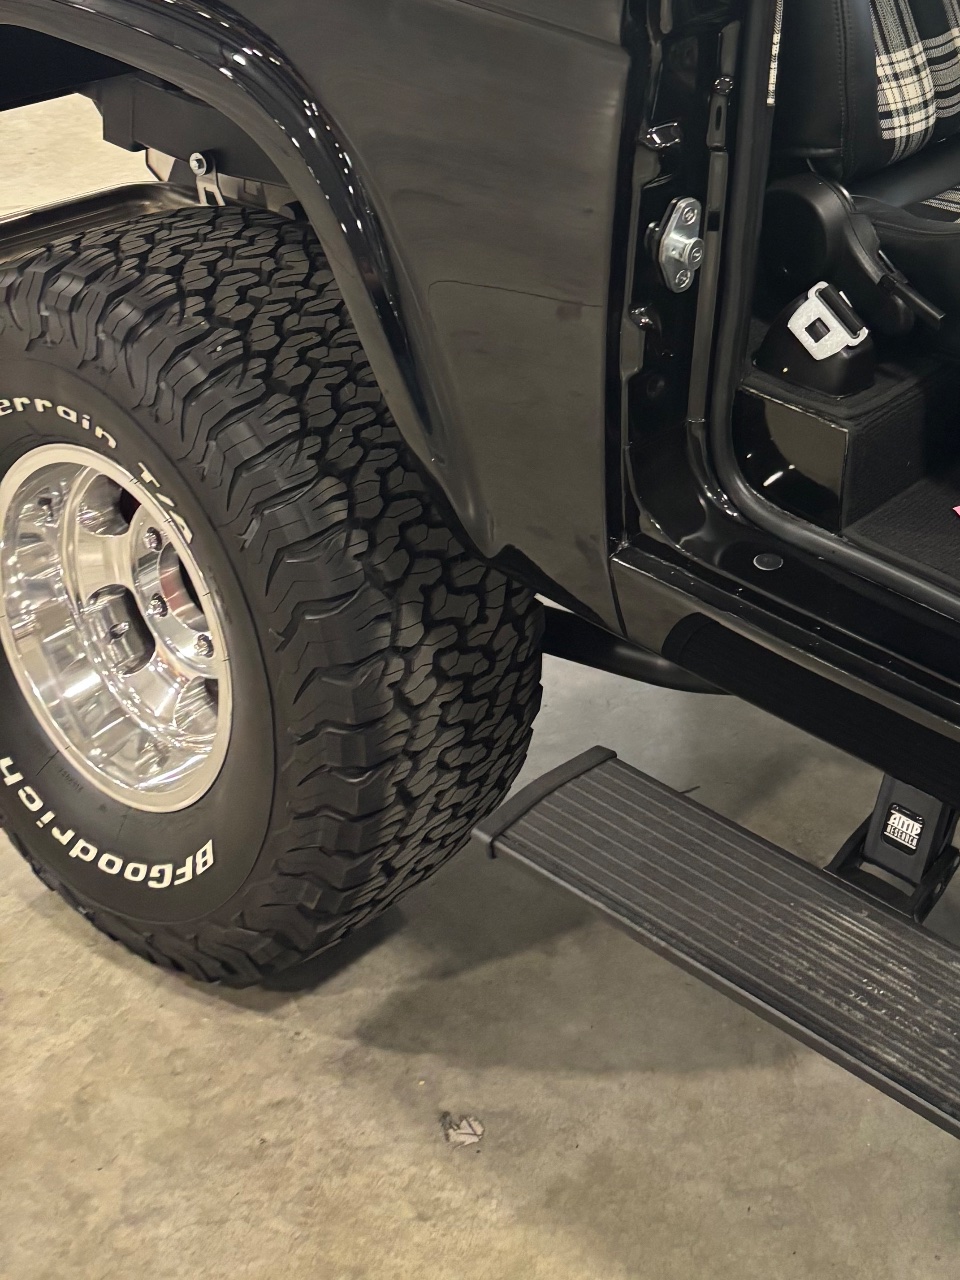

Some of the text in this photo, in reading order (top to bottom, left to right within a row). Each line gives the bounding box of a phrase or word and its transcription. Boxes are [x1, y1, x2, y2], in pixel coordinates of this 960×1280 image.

[138, 462, 193, 544] T/A
[0, 756, 214, 889] BFGoodrich
[887, 811, 921, 837] AMP
